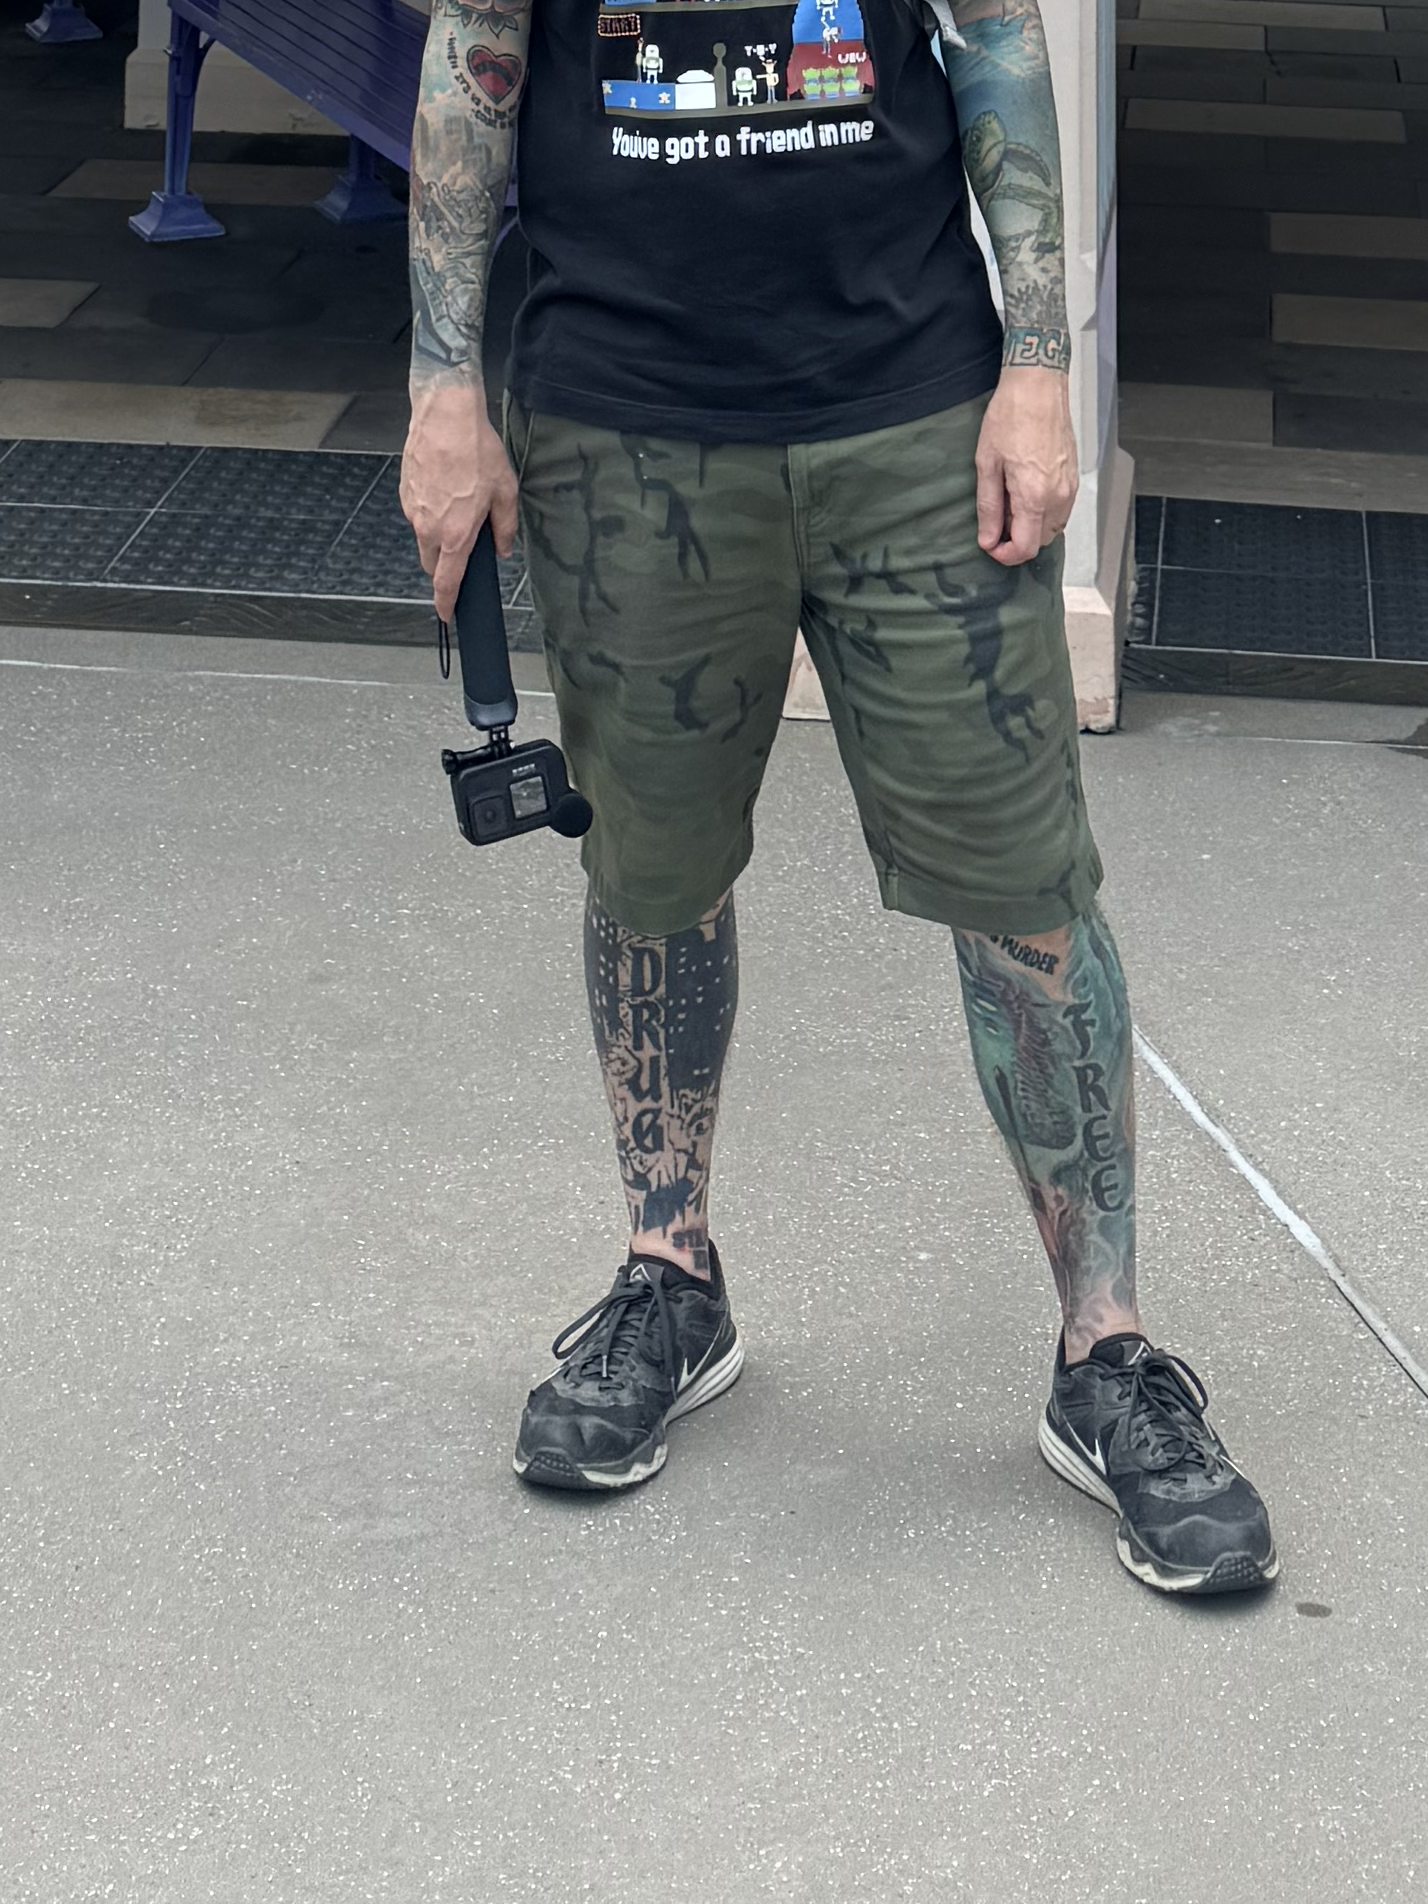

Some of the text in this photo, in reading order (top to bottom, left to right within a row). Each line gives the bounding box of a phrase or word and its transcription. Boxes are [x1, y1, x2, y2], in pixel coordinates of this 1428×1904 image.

[665, 129, 710, 165] got
[715, 134, 731, 158] a
[736, 120, 816, 156] friend
[818, 124, 839, 147] in
[840, 120, 874, 144] me
[1062, 999, 1125, 1213] FREE
